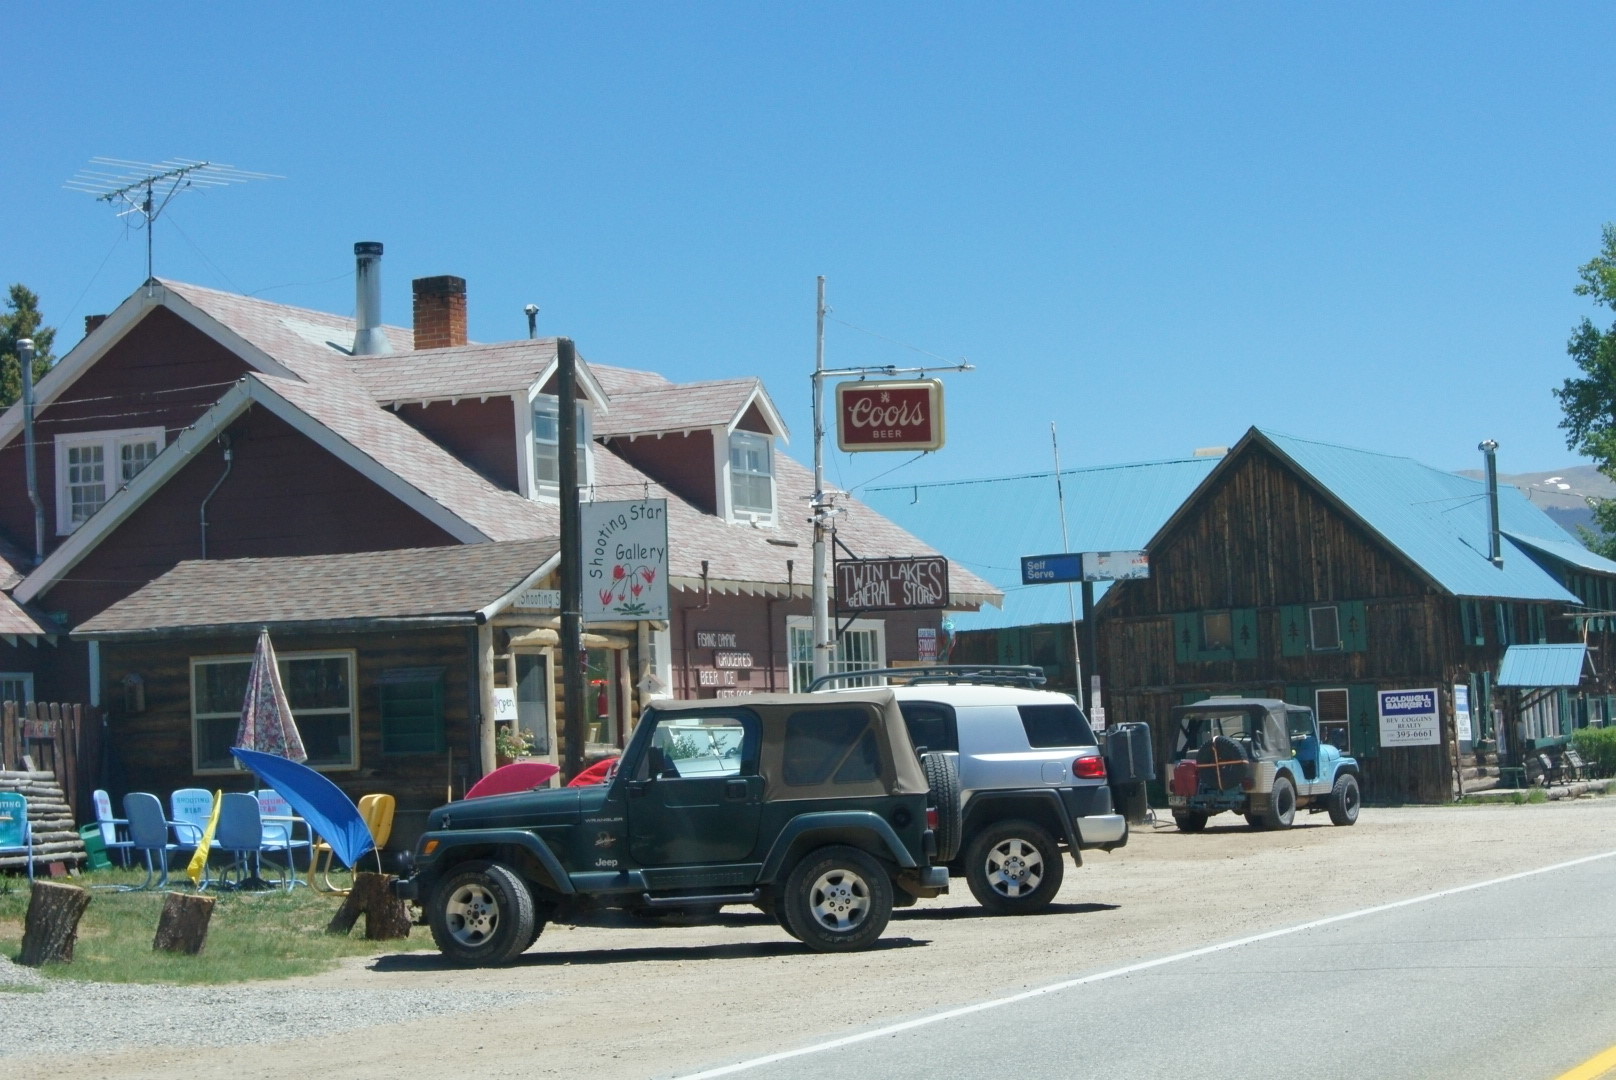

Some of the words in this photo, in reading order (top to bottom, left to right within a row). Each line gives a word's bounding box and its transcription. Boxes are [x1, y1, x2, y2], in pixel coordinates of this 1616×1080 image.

[848, 398, 924, 427] Coors
[873, 430, 902, 438] BEER
[588, 514, 627, 579] Shooting
[630, 504, 662, 520] Star
[615, 543, 664, 563] Gallery
[1027, 561, 1046, 571] Self
[1027, 570, 1055, 579] Serve
[840, 564, 883, 602] TWIN
[889, 562, 942, 599] LAKES
[519, 589, 553, 609] Shooting
[848, 580, 896, 607] GENERAL
[903, 581, 935, 605] STORE
[700, 671, 719, 685] BEER
[724, 671, 735, 685] ICE
[1396, 730, 1432, 738] 395-6661
[595, 858, 618, 867] Jeep
